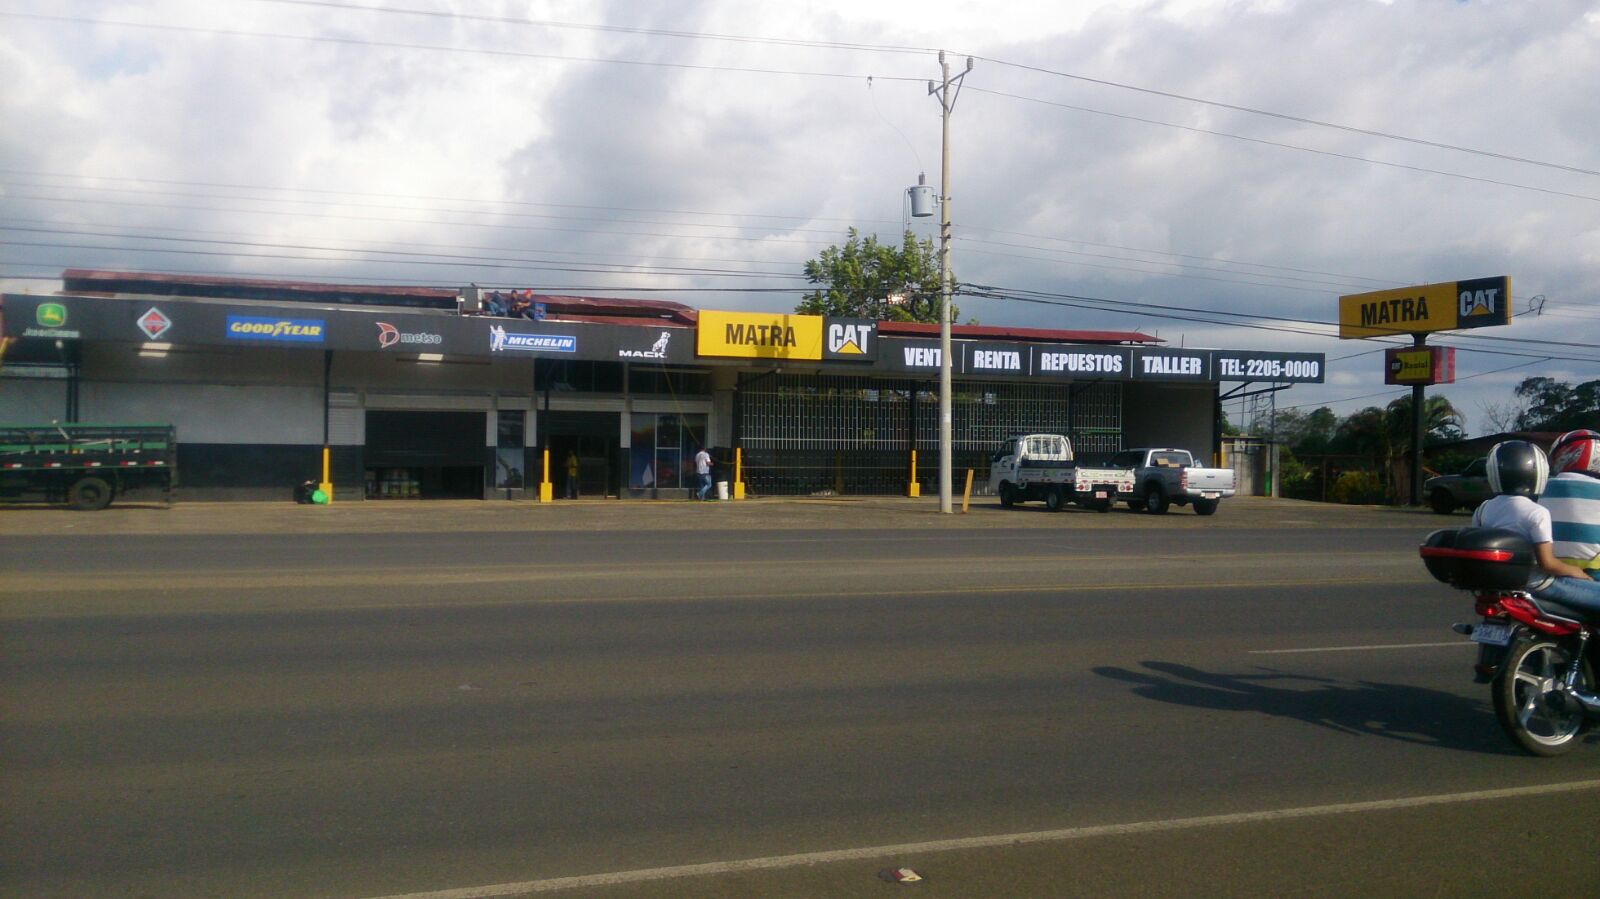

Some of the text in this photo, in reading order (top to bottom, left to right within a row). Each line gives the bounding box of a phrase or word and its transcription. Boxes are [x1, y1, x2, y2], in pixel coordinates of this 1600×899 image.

[1361, 289, 1498, 327] MATRA CAT
[231, 321, 322, 337] GOODYEAR
[400, 333, 443, 345] metso
[725, 323, 872, 354] MATRA CAT
[507, 336, 573, 348] MICHELIN
[618, 349, 665, 359] MACK
[904, 347, 952, 368] VENT
[973, 350, 1021, 370] RENTA
[1041, 352, 1123, 373] REPUESTOS
[1142, 356, 1202, 375] TALLER
[1219, 358, 1319, 378] TEL: 2205-0000
